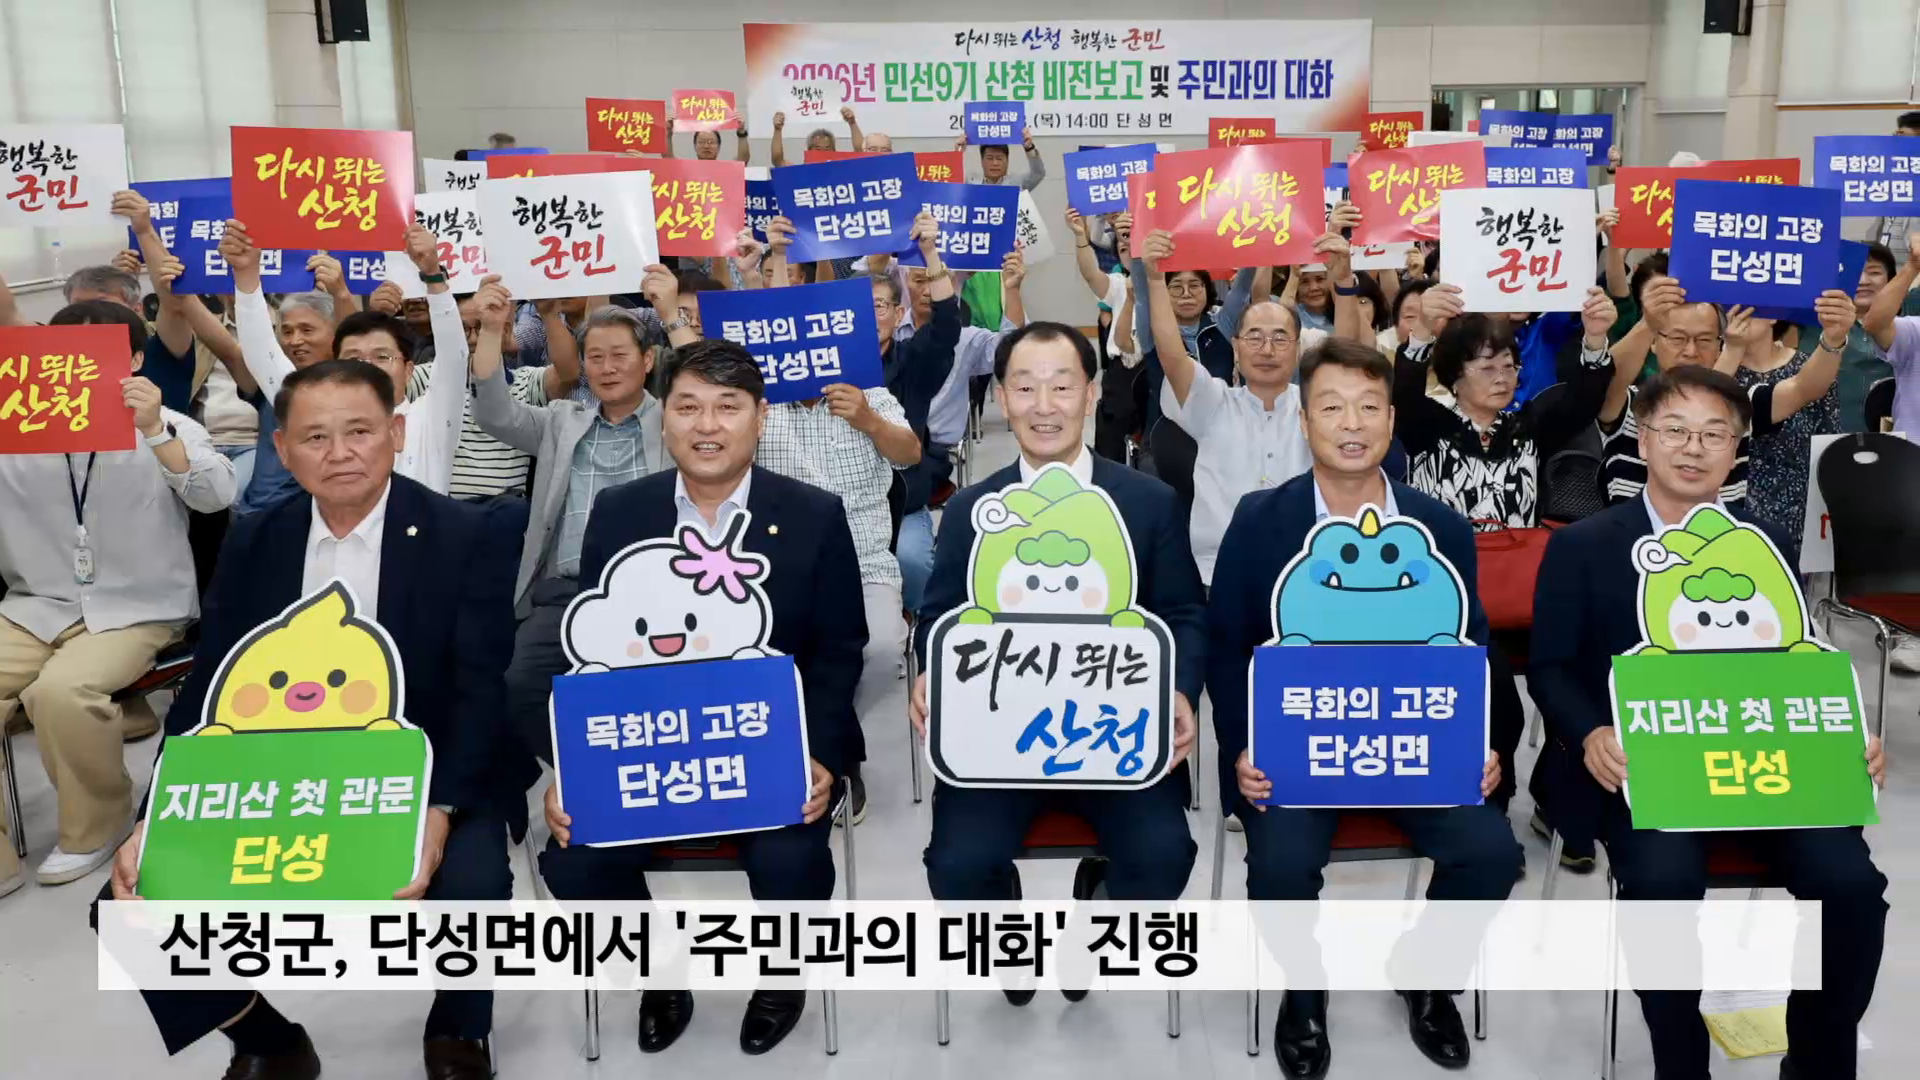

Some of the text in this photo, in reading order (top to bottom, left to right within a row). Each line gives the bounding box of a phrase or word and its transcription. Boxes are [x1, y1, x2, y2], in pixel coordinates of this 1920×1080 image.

[955, 26, 1165, 56] 다시 뛰는 산청 행복한 군민
[884, 61, 977, 102] 민선9기
[985, 60, 1035, 101] 산청
[1043, 60, 1144, 100] 비전보고
[1151, 65, 1169, 98] 및
[1177, 60, 1277, 100] 주민과의
[1285, 59, 1334, 100] 대화
[597, 107, 654, 131] 다시 뛰는
[680, 95, 706, 116] 다시
[796, 100, 827, 116] 군민
[1066, 113, 1108, 128] 14:00
[615, 123, 651, 145] 산청
[978, 125, 1011, 138] 단성면
[1217, 125, 1246, 148] 다시
[1369, 119, 1395, 138] 다시
[254, 146, 387, 198] 다시 뛰는
[1077, 163, 1117, 181] 목화의
[1487, 167, 1574, 184] 목화의 고장
[1829, 155, 1885, 174] 목화의
[6, 174, 88, 212] 군민
[650, 173, 680, 203] 시
[683, 180, 724, 205] 뛰는
[793, 183, 855, 208] 목화의
[861, 177, 902, 202] 고장
[1089, 181, 1129, 203] 단성
[1178, 167, 1241, 220] 다시
[1250, 171, 1300, 199] 뛰는
[1367, 163, 1465, 204] 다시 뛰는
[1844, 180, 1913, 202] 단성면
[297, 184, 378, 232] 산청
[512, 195, 604, 238] 행복한
[655, 202, 718, 240] 산청
[972, 206, 1005, 226] 고장
[1216, 201, 1292, 248] 산청
[1398, 188, 1441, 225] 산
[814, 209, 892, 243] 단성면
[1476, 206, 1564, 252] 행복한
[1693, 211, 1768, 240] 목화의
[1776, 216, 1823, 244] 고장
[205, 249, 283, 276] 단면
[349, 257, 387, 281] 단성
[437, 241, 489, 278] 군민
[530, 233, 616, 280] 군민
[1487, 248, 1567, 293] 군민
[1711, 249, 1802, 285] 단성면
[722, 309, 855, 346] 목화의 고장
[37, 354, 101, 385] 뛰는
[0, 384, 90, 433] 산청
[953, 629, 1150, 712] 다시 뛰는
[1282, 686, 1457, 720] 목화의 고장
[1626, 696, 1854, 735] 지리산 첫 관문
[586, 701, 770, 751] 목화의 고장
[1015, 700, 1150, 777] 산청
[1308, 735, 1429, 776] 단성면
[1704, 750, 1791, 796] 단성
[158, 775, 415, 821] 지리산 첫 관문
[618, 754, 747, 808] 단성면
[230, 834, 329, 885] 단성
